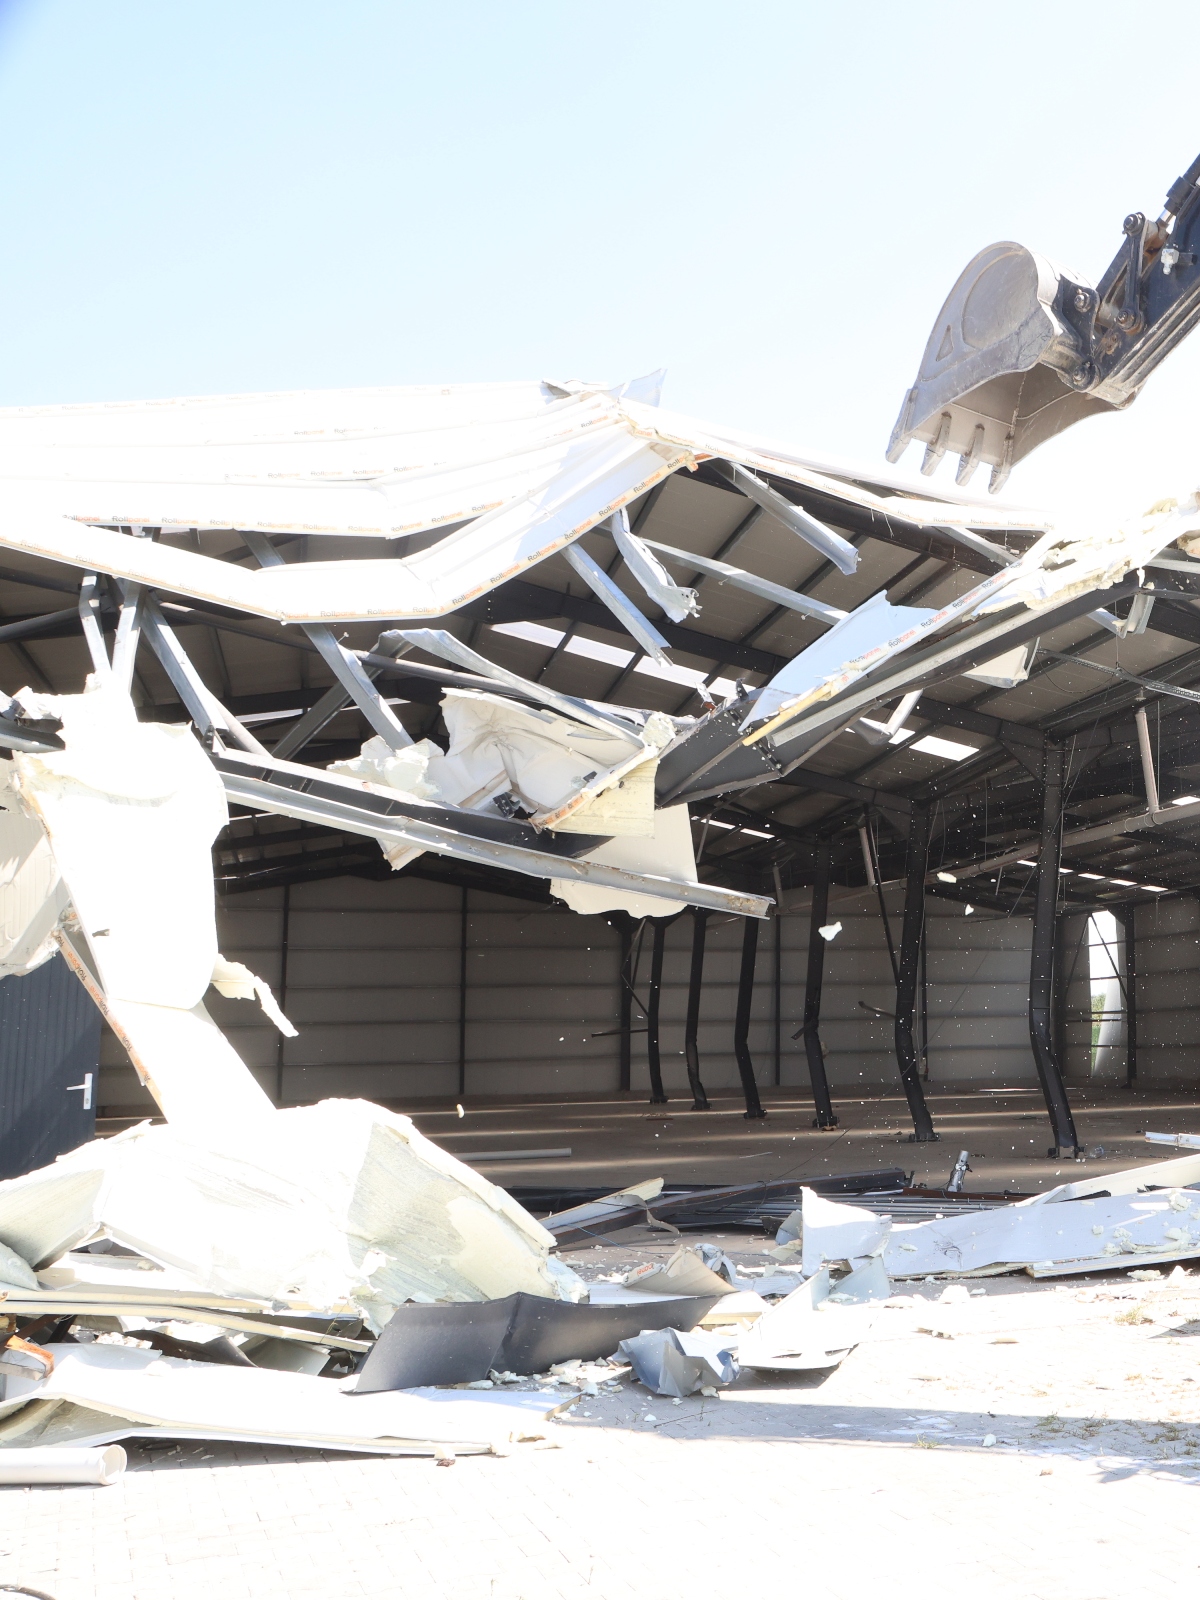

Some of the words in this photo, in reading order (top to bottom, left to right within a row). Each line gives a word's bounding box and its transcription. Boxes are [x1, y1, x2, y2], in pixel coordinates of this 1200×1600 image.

[112, 515, 150, 523] Rollpanel
[161, 516, 199, 525] Rollpanel
[431, 510, 463, 524] Rollpanel
[472, 499, 504, 513] Rollpanel
[452, 584, 483, 606] Rollpanel
[490, 563, 521, 584] Rollpanel
[527, 541, 558, 562] Rollpanel
[564, 519, 593, 541] Rollpanel
[598, 495, 628, 517] Rollpanel
[633, 471, 662, 494] Rollpanel
[888, 629, 917, 648] Rollpanel
[920, 610, 949, 629] Rollpanel
